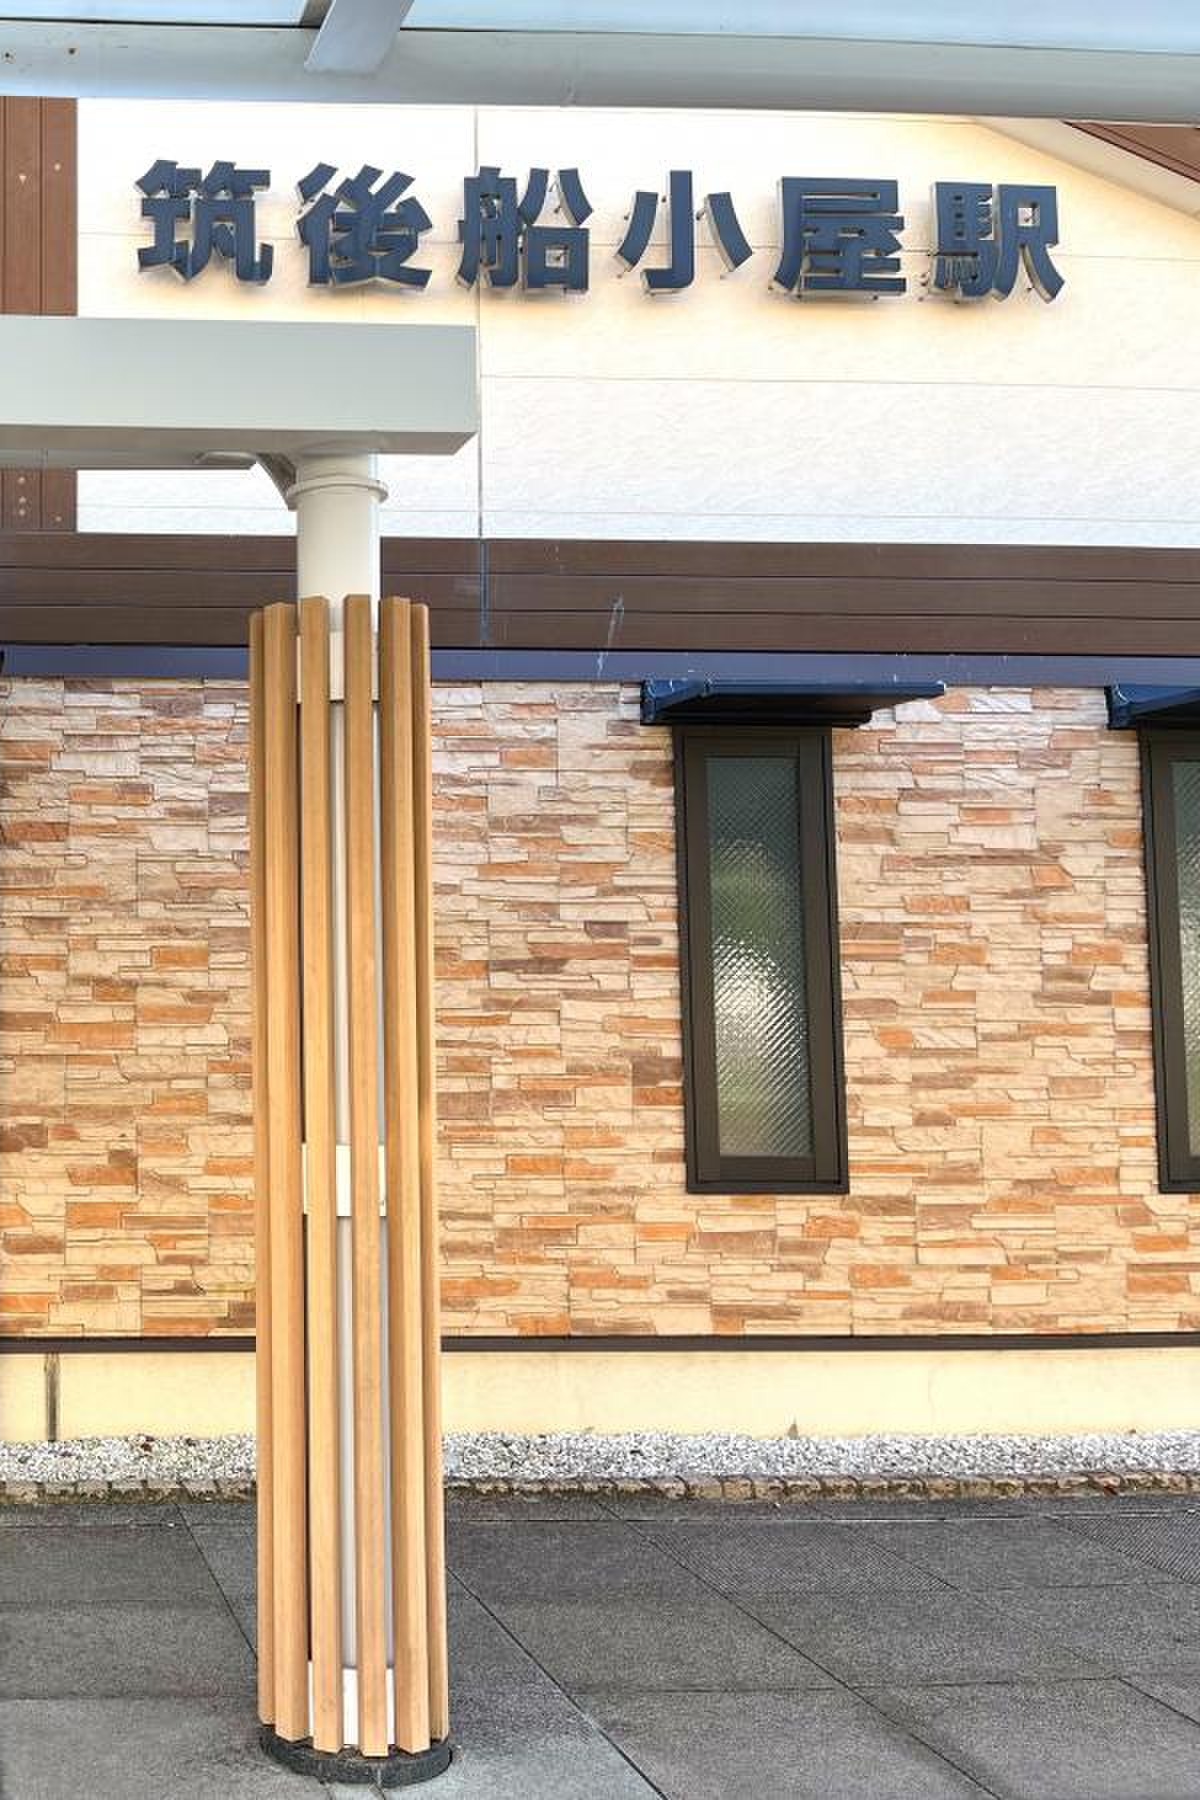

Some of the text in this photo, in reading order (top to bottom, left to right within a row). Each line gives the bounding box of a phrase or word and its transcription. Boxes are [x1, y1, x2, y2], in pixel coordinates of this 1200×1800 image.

[135, 160, 1064, 302] 筑後船小屋駅
